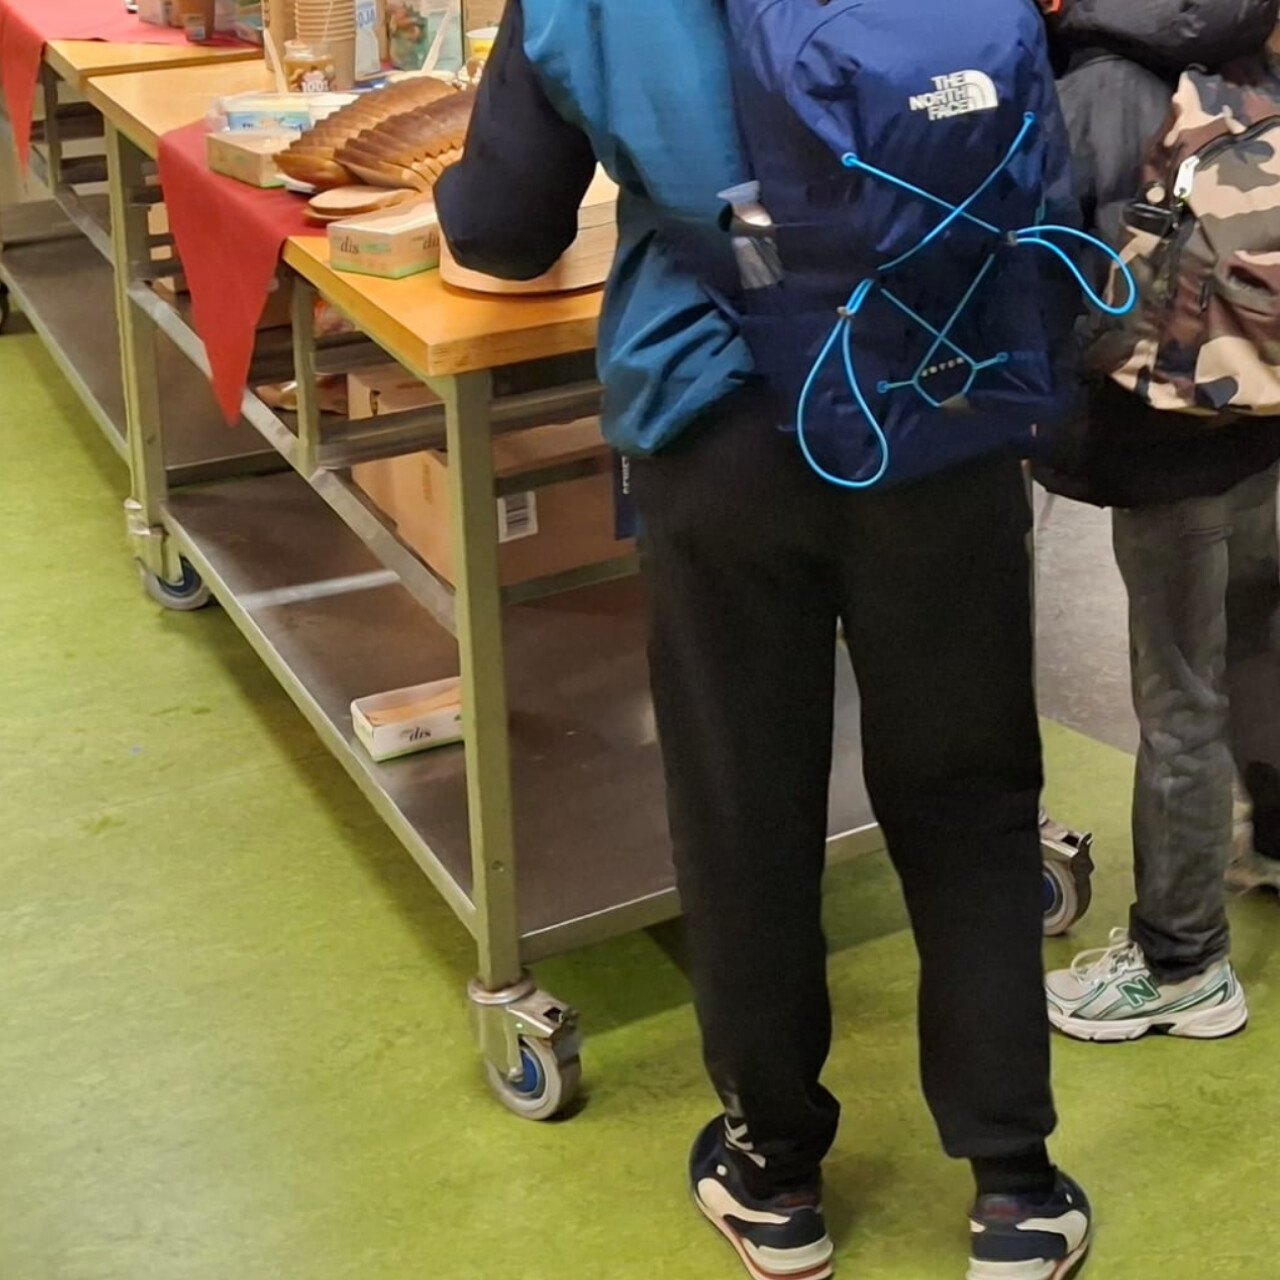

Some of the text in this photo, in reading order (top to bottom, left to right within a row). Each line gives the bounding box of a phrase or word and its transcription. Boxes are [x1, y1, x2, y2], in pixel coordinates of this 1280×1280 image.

[931, 73, 964, 90] THE
[909, 87, 968, 111] NORTH
[928, 99, 972, 120] FACE
[1117, 974, 1161, 1009] N
